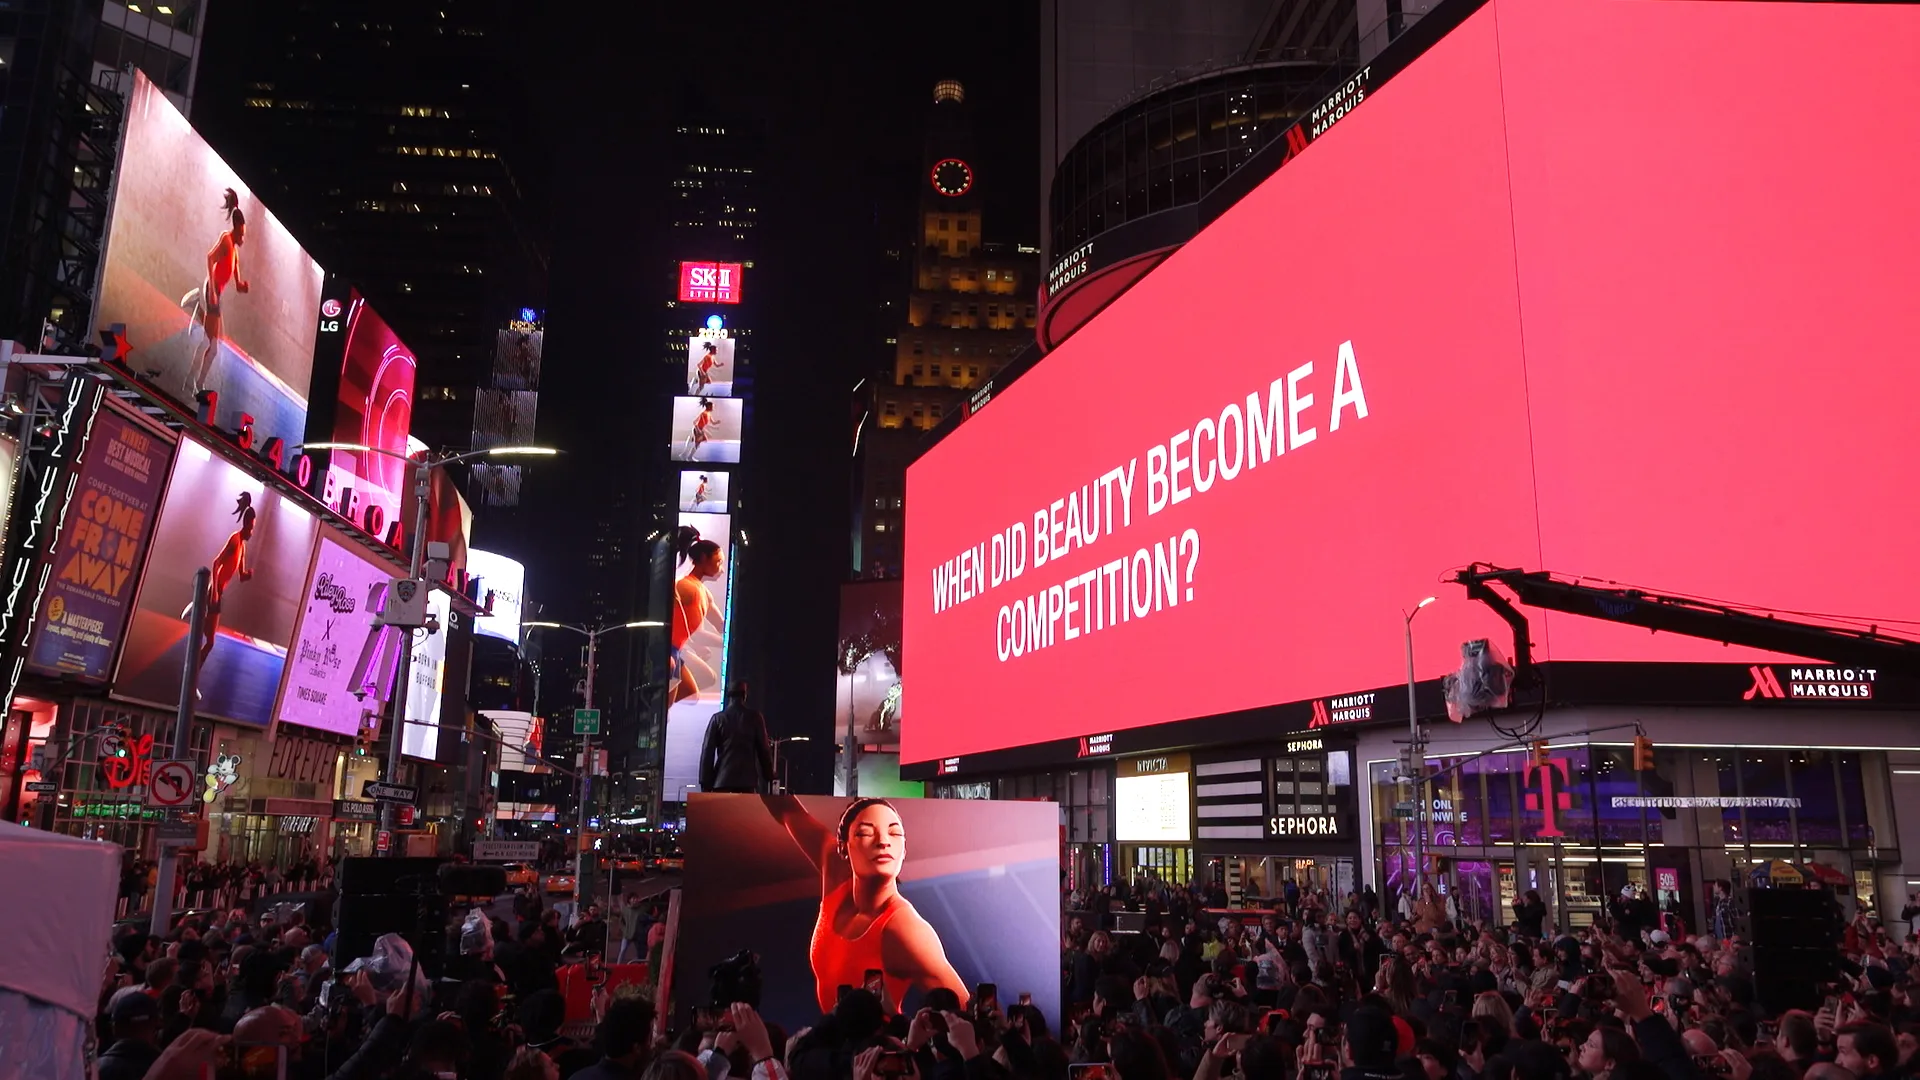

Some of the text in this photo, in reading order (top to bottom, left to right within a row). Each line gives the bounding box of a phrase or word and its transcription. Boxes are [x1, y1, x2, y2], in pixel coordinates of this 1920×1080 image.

[1312, 66, 1371, 123] MARRIOTT
[1312, 89, 1365, 139] MARQUIS
[1049, 242, 1094, 282] MARRIOTT
[1049, 261, 1088, 297] MARQUIS
[320, 320, 339, 332] LG
[87, 476, 108, 493] COME
[932, 340, 1369, 614] WHEN DID BEAUTY BECOME A
[81, 489, 145, 541] COME
[58, 551, 130, 597] AWAY
[314, 572, 341, 606] Riley
[996, 528, 1200, 662] COMPETITION?
[330, 586, 356, 614] Rose
[300, 639, 323, 667] Pinky
[418, 652, 433, 667] BORN
[297, 686, 328, 706] TIMES SQUARE
[1793, 684, 1869, 698] MARQUIS
[1331, 693, 1375, 709] MARRIOTT
[1332, 707, 1371, 722] MARQUIS
[1287, 738, 1323, 753] SEPHORA
[1136, 757, 1168, 773] INVICTA
[371, 786, 411, 799] ONE WAY
[350, 802, 363, 813] POLO
[280, 815, 312, 832] FOREVER
[1271, 816, 1338, 835] SEPHORA
